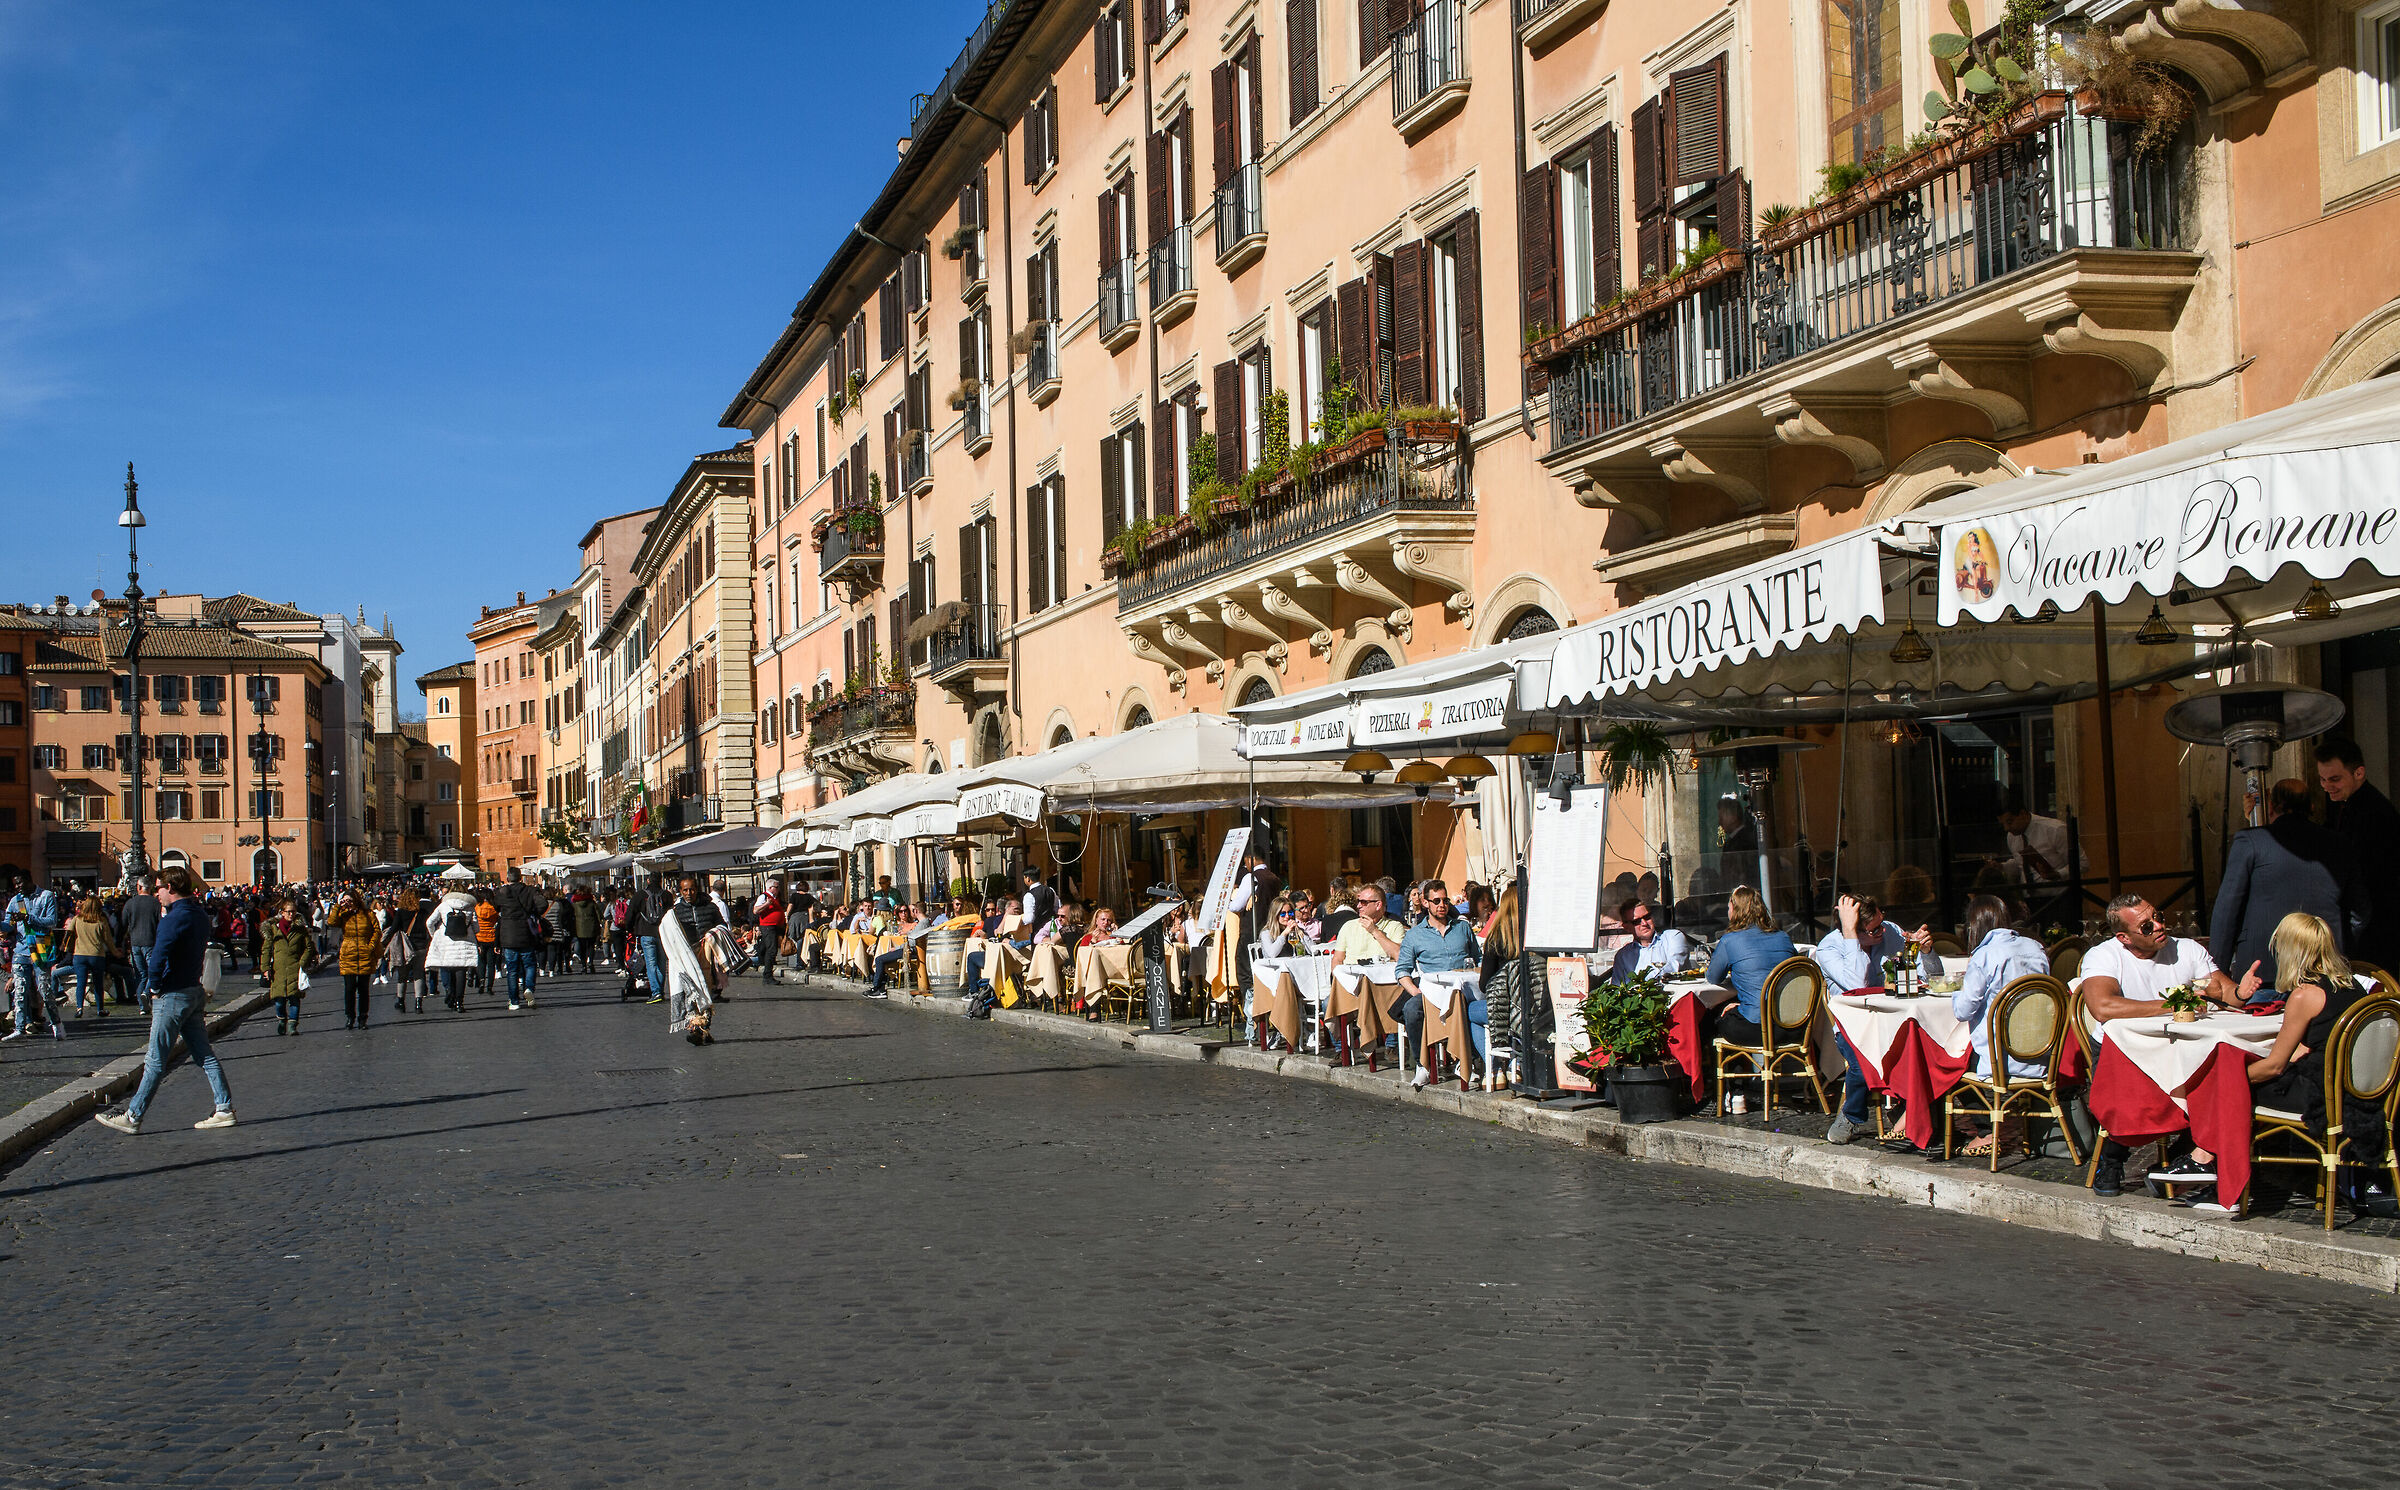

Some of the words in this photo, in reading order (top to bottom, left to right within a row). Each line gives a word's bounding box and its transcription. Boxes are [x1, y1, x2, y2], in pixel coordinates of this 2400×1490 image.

[2007, 506, 2166, 597] Vacanze
[2178, 475, 2397, 563] Romane
[1597, 559, 1827, 685] RISTORANTE
[1327, 720, 1345, 740] BAR
[1369, 711, 1411, 734] PIZZERIA
[1441, 696, 1505, 725] TRATTORIA
[964, 789, 1011, 819] RISTORATE
[1150, 924, 1166, 1027] RISTORANTE
